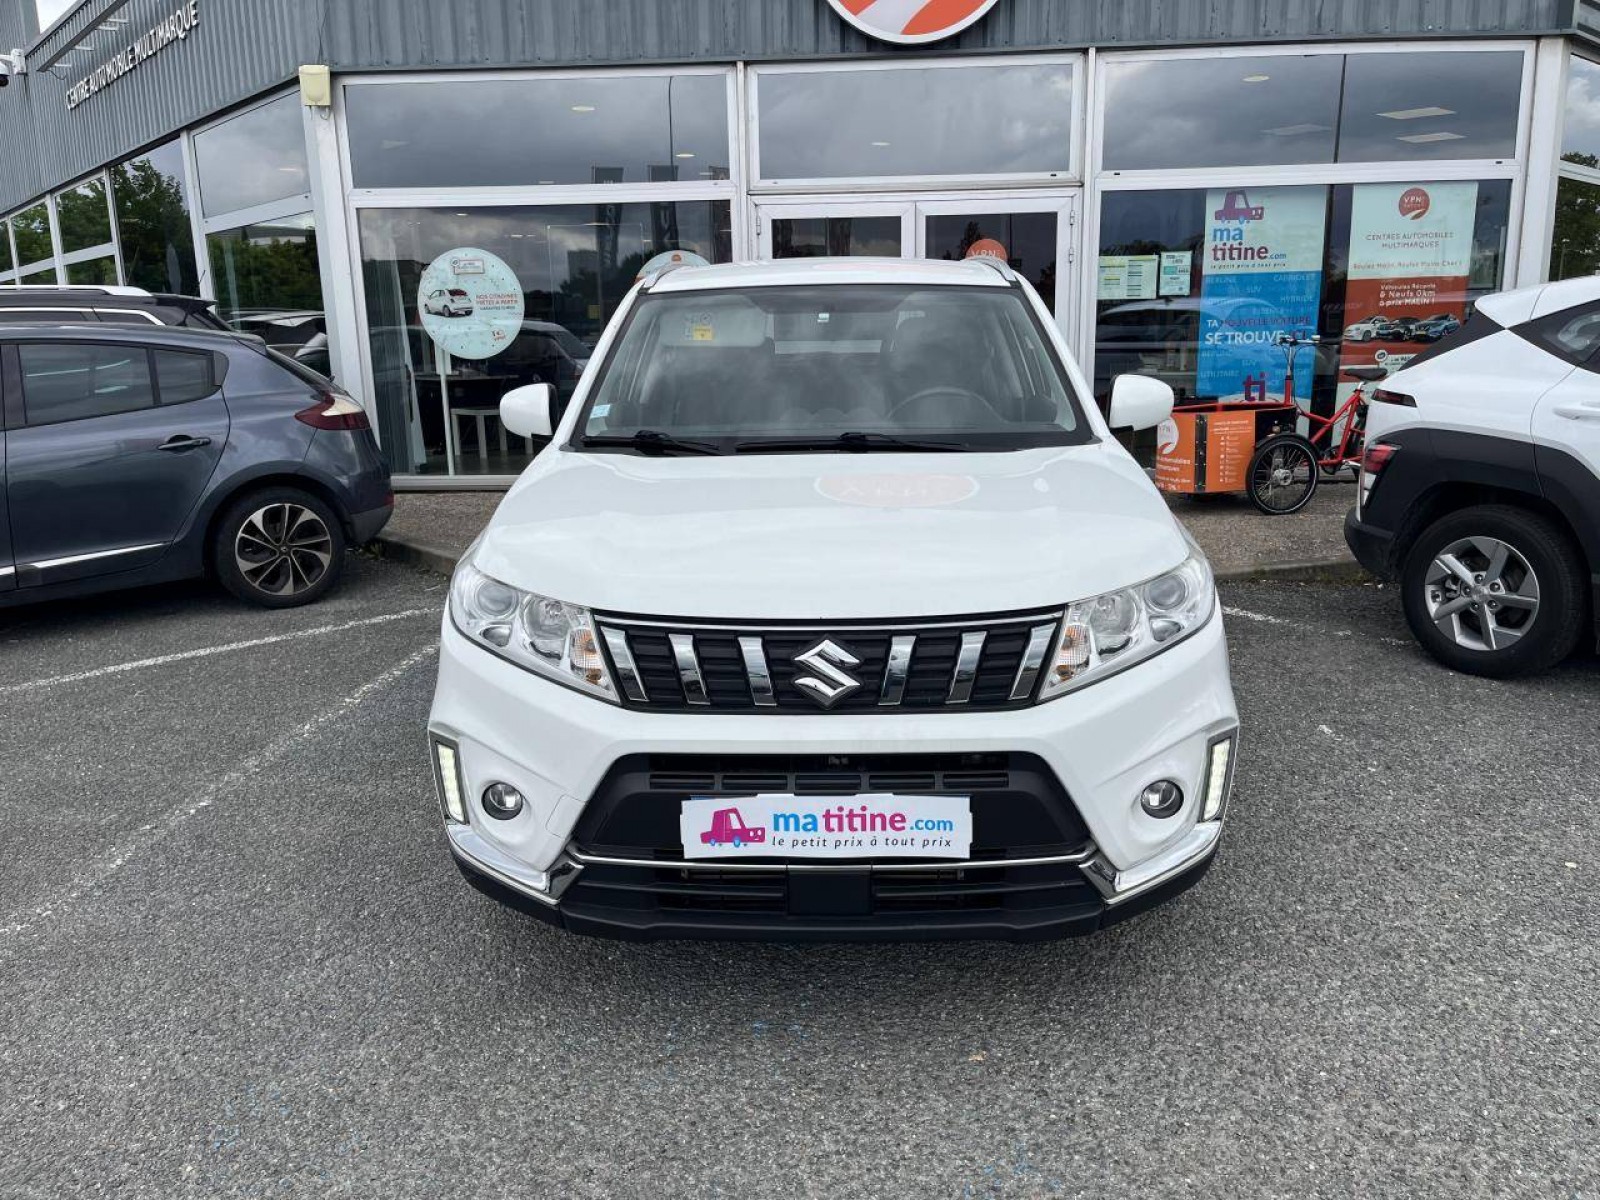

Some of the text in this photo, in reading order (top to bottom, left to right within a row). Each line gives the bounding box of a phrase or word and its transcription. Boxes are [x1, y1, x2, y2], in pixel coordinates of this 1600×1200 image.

[66, 0, 199, 109] CENTRE AUTOMOBILE MULTIMARQUE
[1213, 227, 1243, 242] ma
[1366, 231, 1455, 241] CENTRES AUTOMOBILES
[1381, 240, 1440, 249] MULTIMARQUES
[1206, 319, 1219, 328] TA
[1205, 332, 1222, 345] SE
[1223, 330, 1286, 345] TROUVE
[772, 835, 952, 849] le petit prix à tout prix
